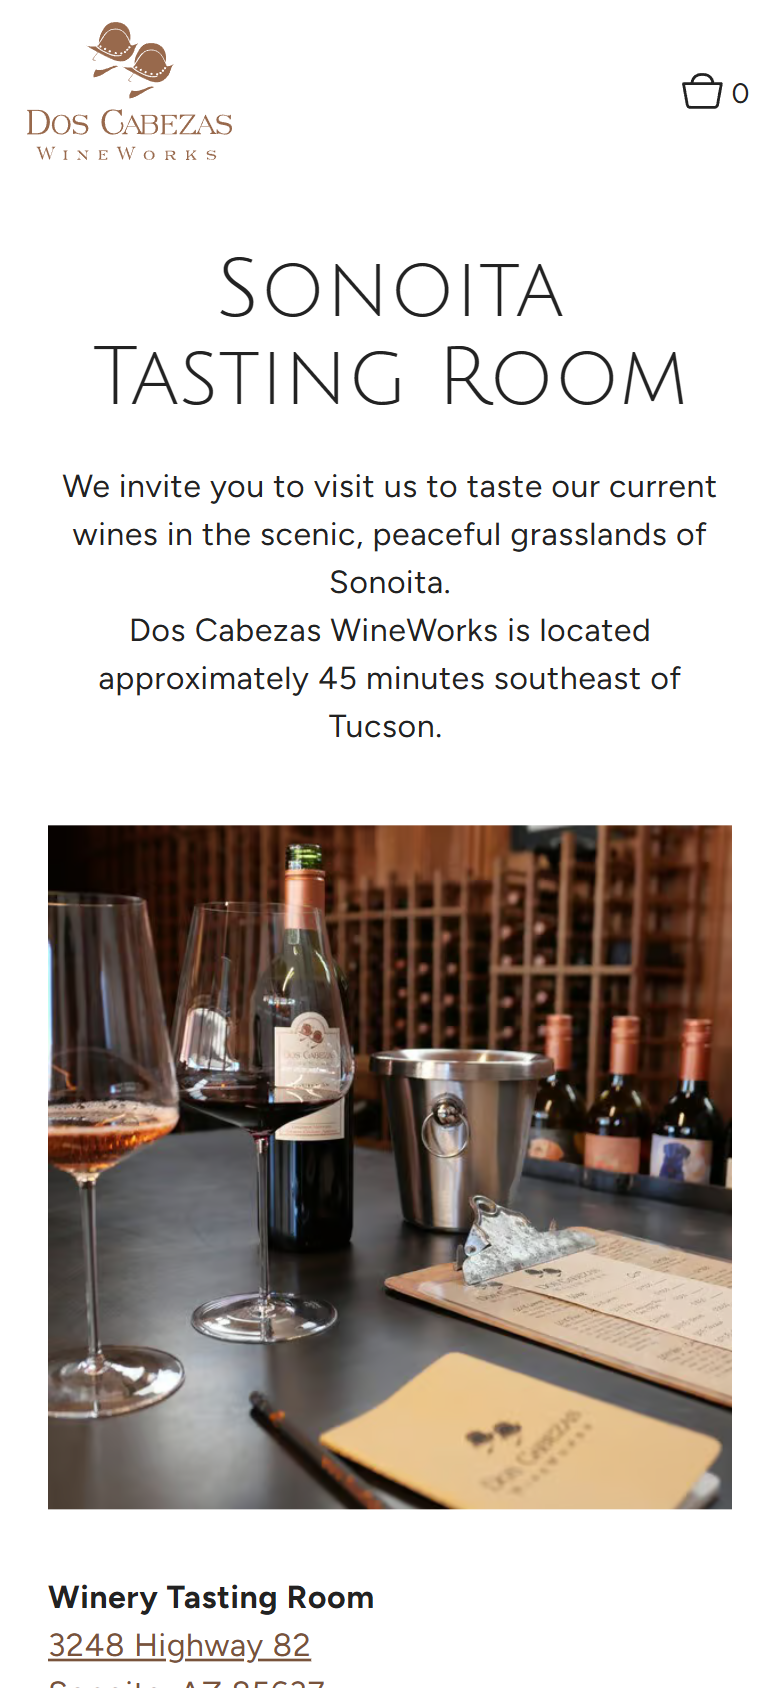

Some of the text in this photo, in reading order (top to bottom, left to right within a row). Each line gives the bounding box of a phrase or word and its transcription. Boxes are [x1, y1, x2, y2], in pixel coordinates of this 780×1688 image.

[733, 83, 748, 104] 0
[27, 109, 232, 135] DOS CABEZAS
[220, 257, 563, 317] SONOITA
[94, 346, 683, 405] TASTING ROOM
[63, 474, 716, 504] We invite you to visit us to taste our current
[73, 522, 707, 552] wines in the scenic, peaceful grasslands of
[331, 570, 449, 594] Sonoita.
[132, 618, 649, 642] Dos Cabezas WineWorks is located
[100, 666, 681, 696] approximately 45 minutes southeast of
[329, 714, 441, 738] Tucson.
[48, 1584, 373, 1615] Winery Tasting Room
[49, 1633, 310, 1663] 3248 Highway 82
